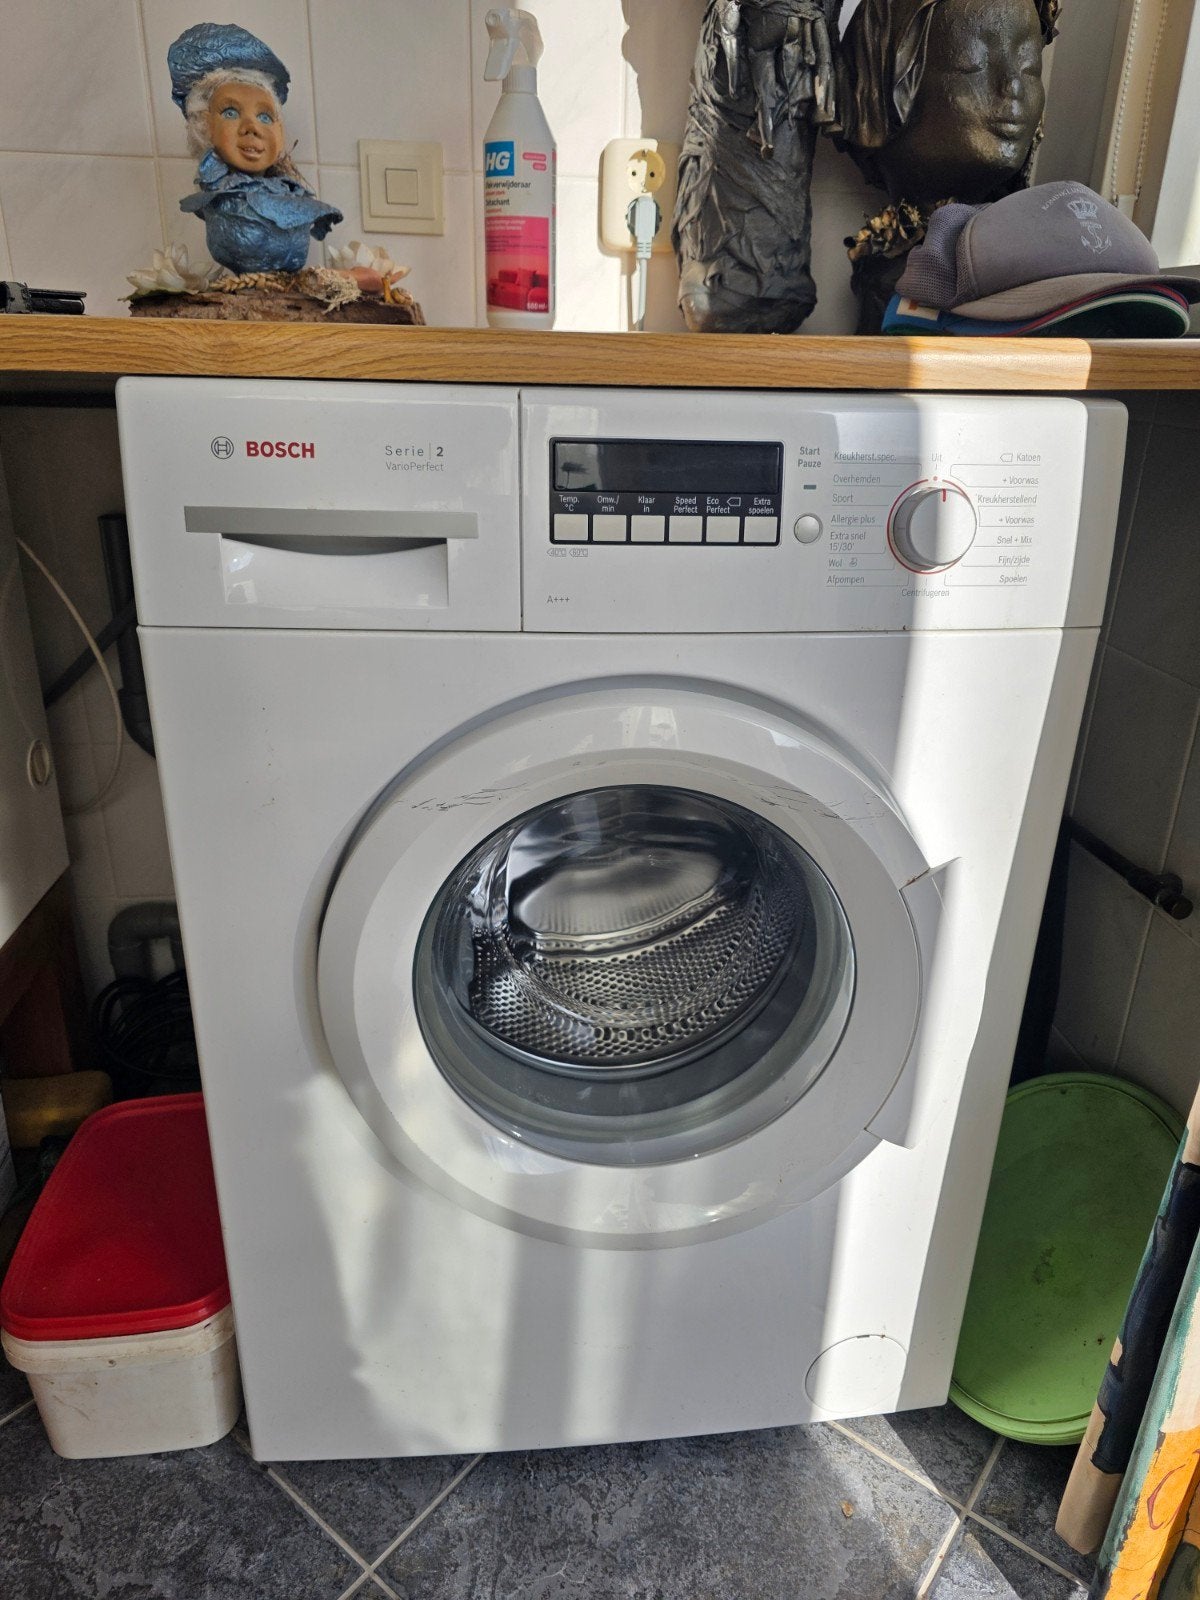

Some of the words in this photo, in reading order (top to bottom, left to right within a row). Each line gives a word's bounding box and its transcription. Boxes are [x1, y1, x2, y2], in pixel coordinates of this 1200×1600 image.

[486, 151, 510, 171] HG
[246, 441, 315, 459] BOSCH
[385, 445, 424, 457] Serie
[436, 446, 444, 458] 2
[799, 446, 821, 456] Start
[931, 453, 942, 462] Uit
[1017, 453, 1041, 462] Katoen
[385, 461, 444, 472] VarioPerfect
[798, 459, 821, 468] Pauze
[833, 474, 881, 484] Overhemden
[1009, 476, 1039, 485] Voorwas
[559, 495, 580, 505] Temp.
[597, 495, 620, 504] Omw./
[638, 496, 655, 504] Klaar
[675, 496, 697, 506] Speed
[706, 497, 719, 505] Eco
[753, 497, 771, 506] Extra
[832, 494, 854, 504] Sport
[977, 494, 1037, 504] Kreukherstellend
[565, 503, 574, 512] °C
[601, 505, 615, 513] min
[643, 505, 650, 513] in
[673, 505, 698, 514] Perfect
[706, 506, 730, 514] Perfect
[749, 507, 774, 516] spoelen
[831, 514, 859, 524] Allergie
[860, 515, 875, 524] plus
[1005, 515, 1034, 524] Voorwas
[830, 532, 848, 540] Extra
[848, 532, 866, 540] snel
[997, 536, 1012, 544] Snel
[1020, 535, 1032, 544] Mix
[828, 559, 842, 567] Wol
[998, 555, 1030, 565] Fijn/zijde
[827, 575, 865, 585] Afpompen
[999, 574, 1027, 584] Spoelen
[901, 588, 950, 597] Centrifugeren
[547, 595, 570, 604] A+++
